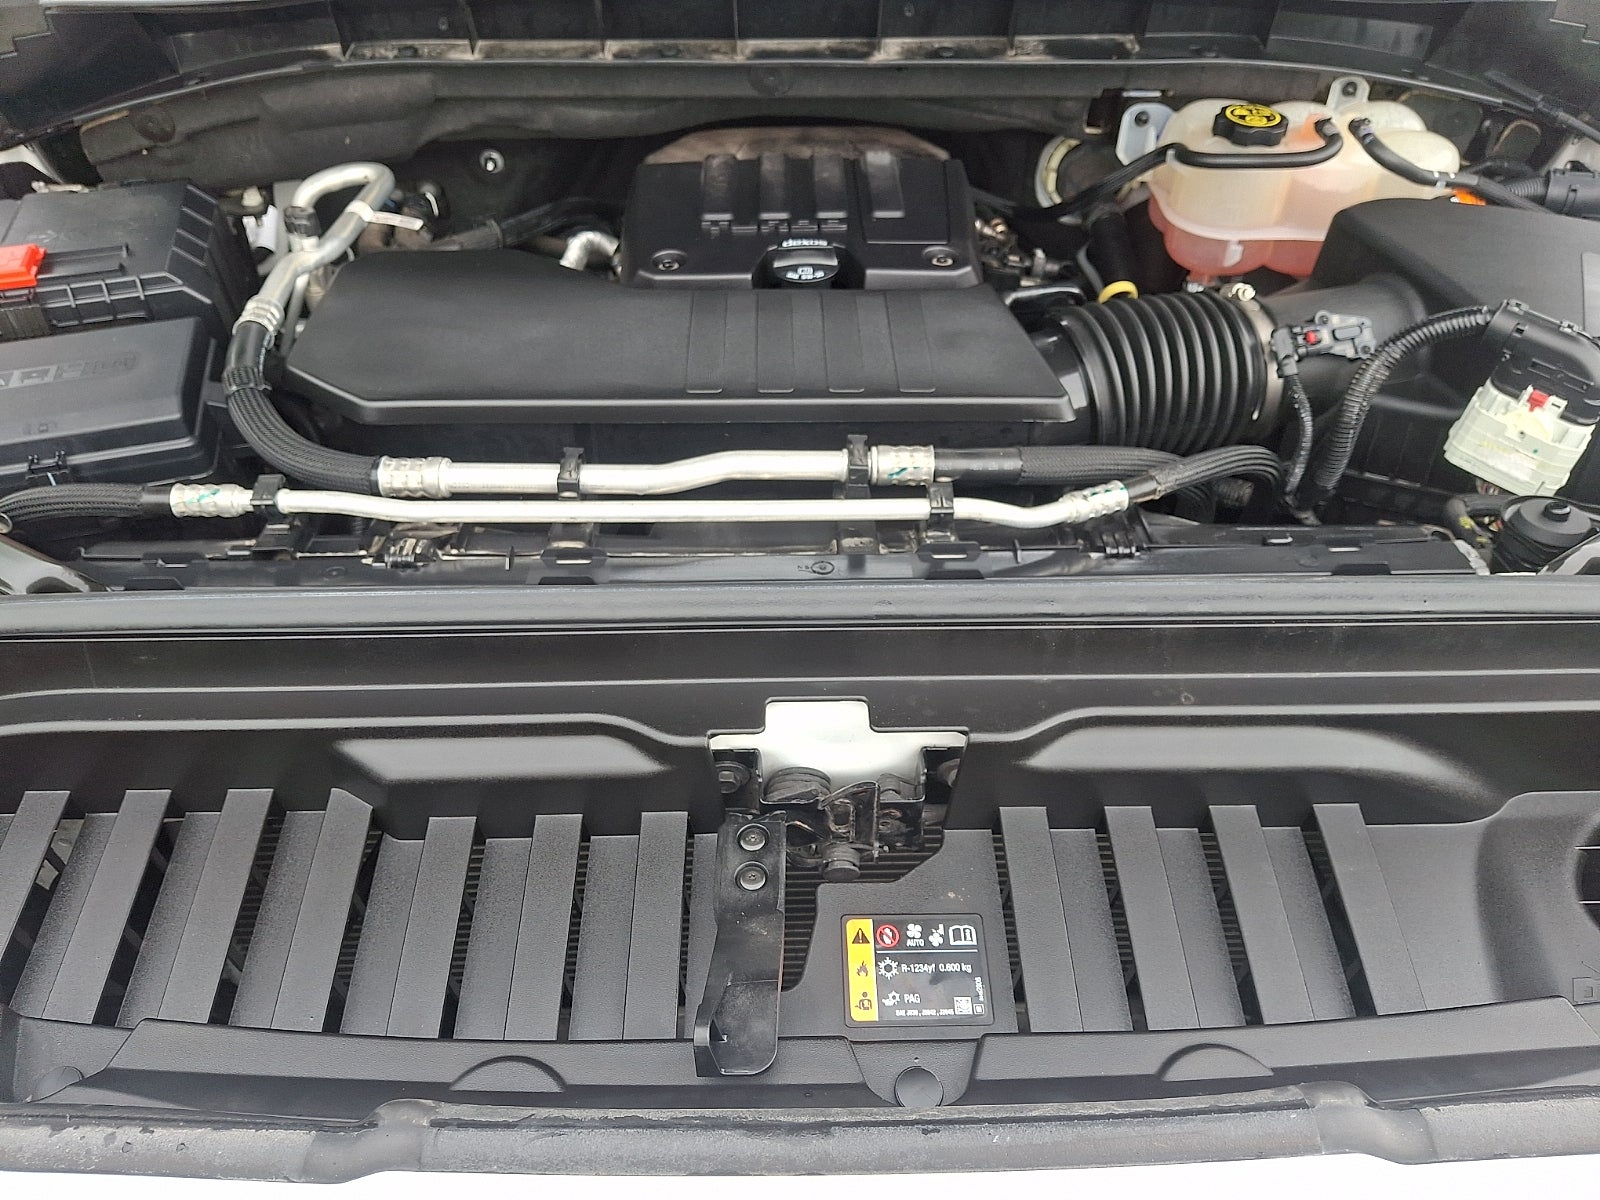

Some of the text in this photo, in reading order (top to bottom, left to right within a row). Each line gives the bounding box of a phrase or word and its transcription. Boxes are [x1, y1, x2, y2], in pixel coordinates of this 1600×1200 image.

[906, 938, 925, 947] AUTO
[962, 963, 973, 973] kg
[904, 993, 921, 1003] PAG
